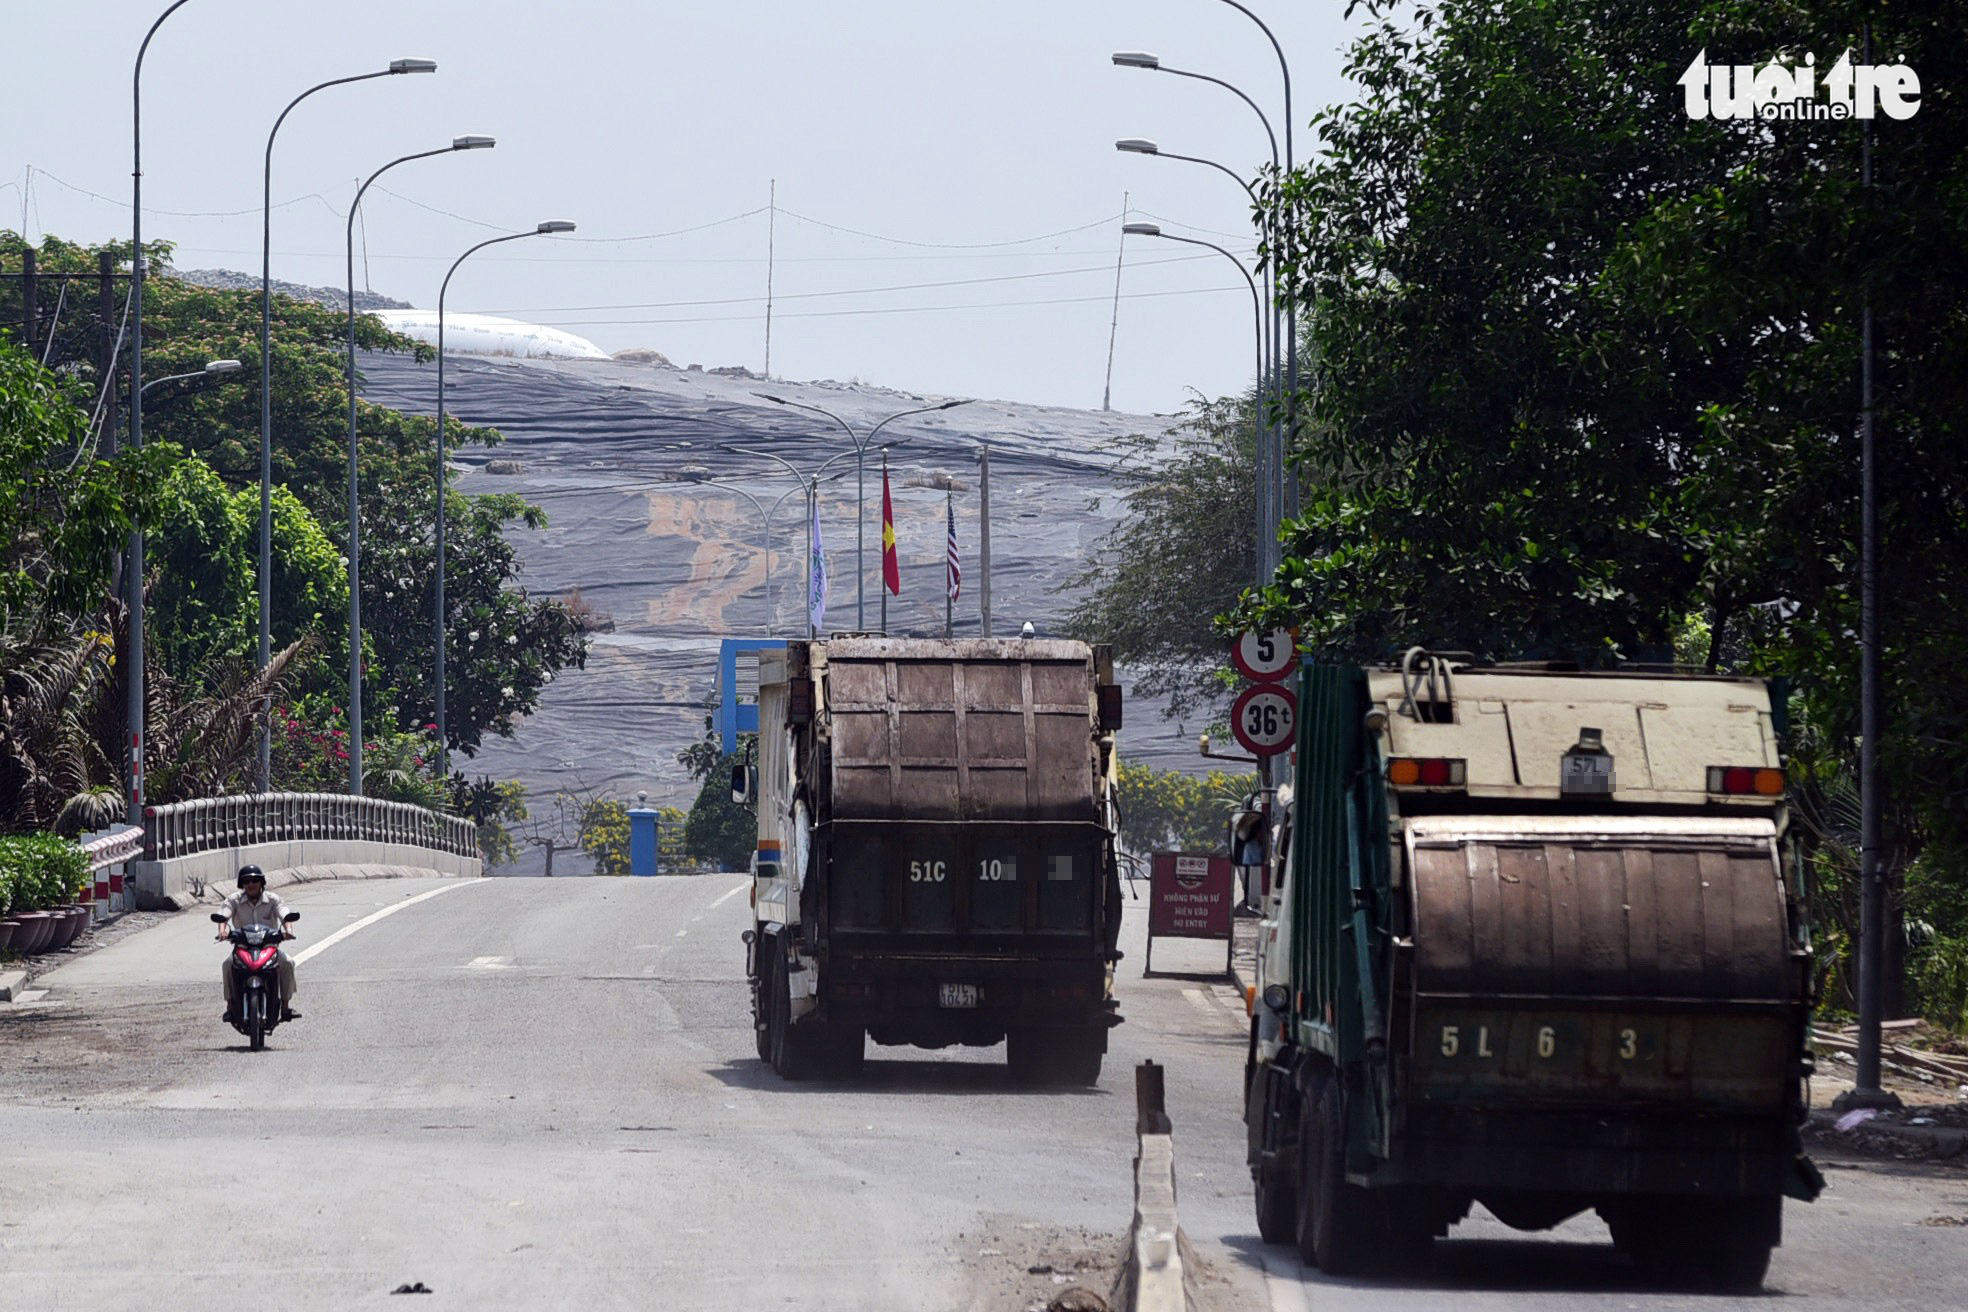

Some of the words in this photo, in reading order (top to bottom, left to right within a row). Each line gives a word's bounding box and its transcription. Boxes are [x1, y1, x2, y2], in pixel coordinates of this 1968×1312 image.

[1257, 631, 1275, 663] 5
[910, 860, 946, 882] 51C
[979, 859, 1016, 881] 10
[1185, 920, 1208, 929] ENTRY
[1538, 1027, 1556, 1058] 6
[1620, 1029, 1638, 1060] 3
